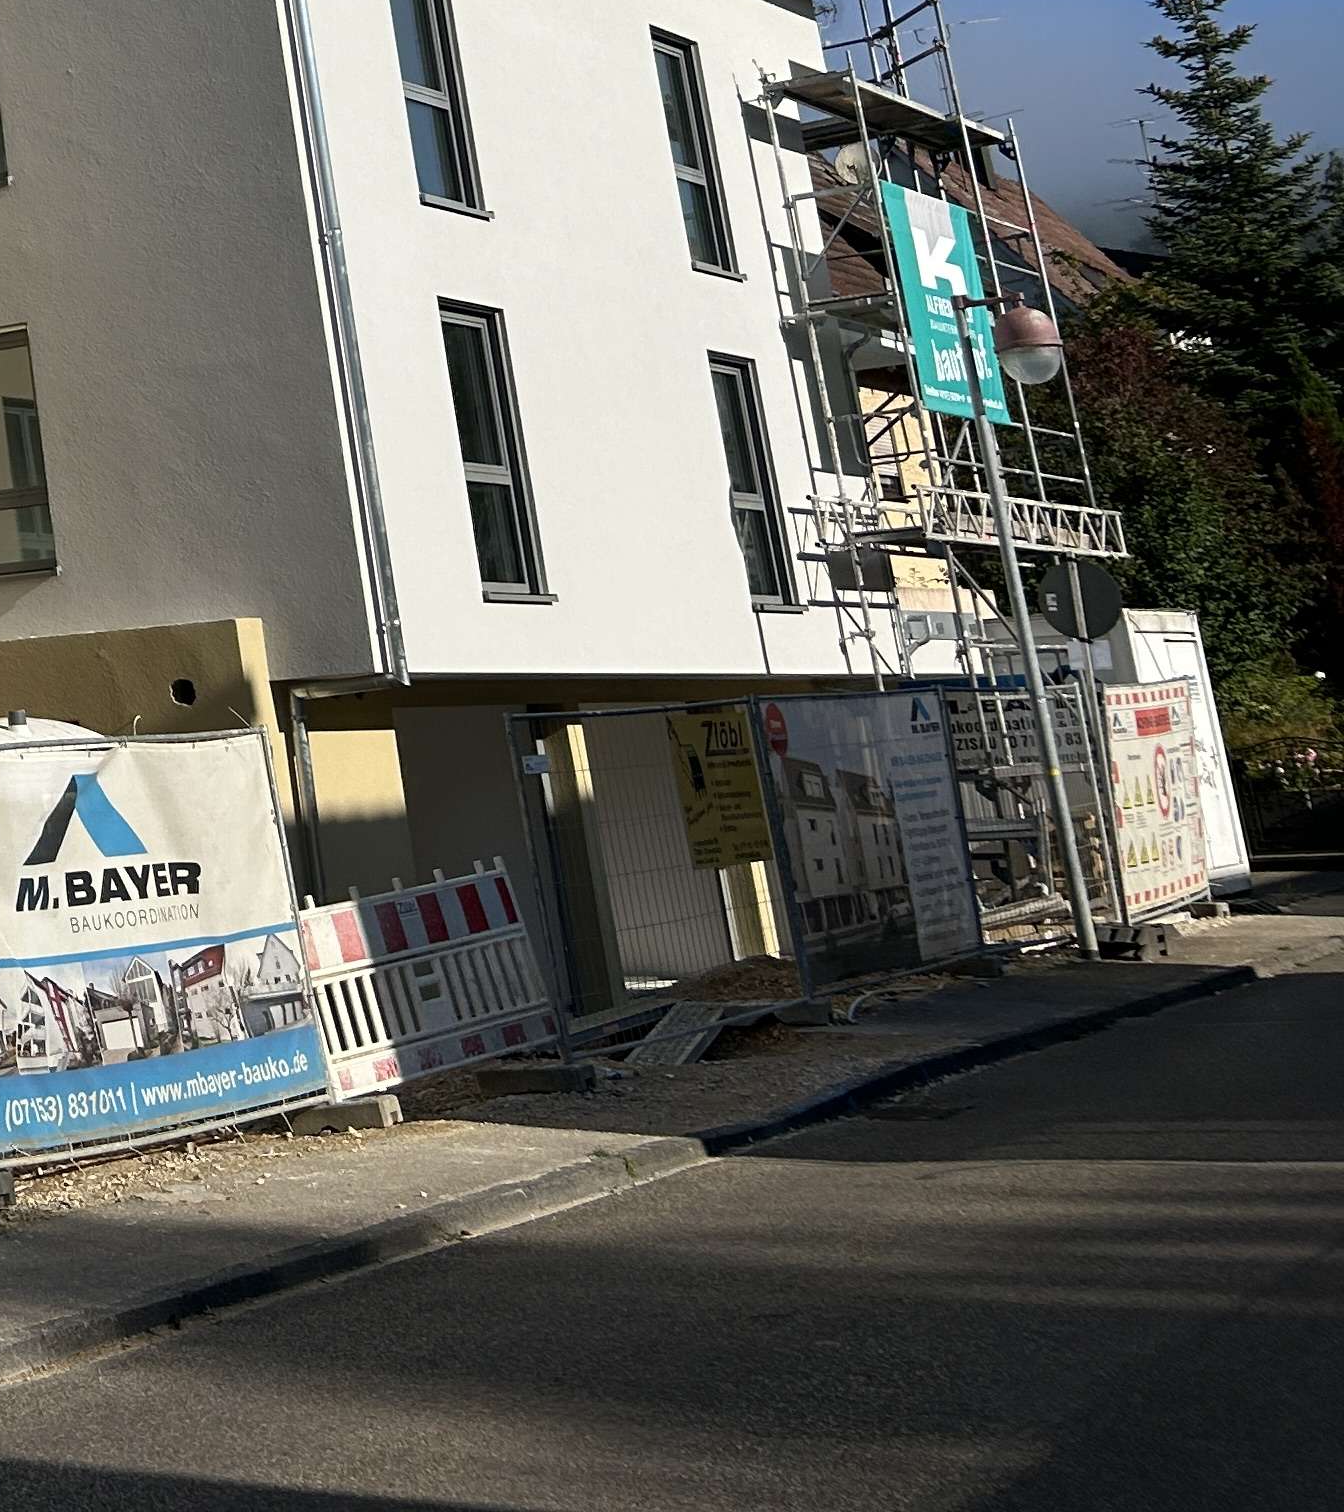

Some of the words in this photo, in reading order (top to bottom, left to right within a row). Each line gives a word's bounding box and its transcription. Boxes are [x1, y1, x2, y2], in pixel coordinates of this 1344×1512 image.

[65, 862, 202, 907] BAYER
[70, 904, 200, 934] BAUKOORDINATION
[5, 1094, 63, 1132] (07153)
[68, 1086, 127, 1120] 831011
[140, 1049, 309, 1107] www.mbayer-bauko.de
